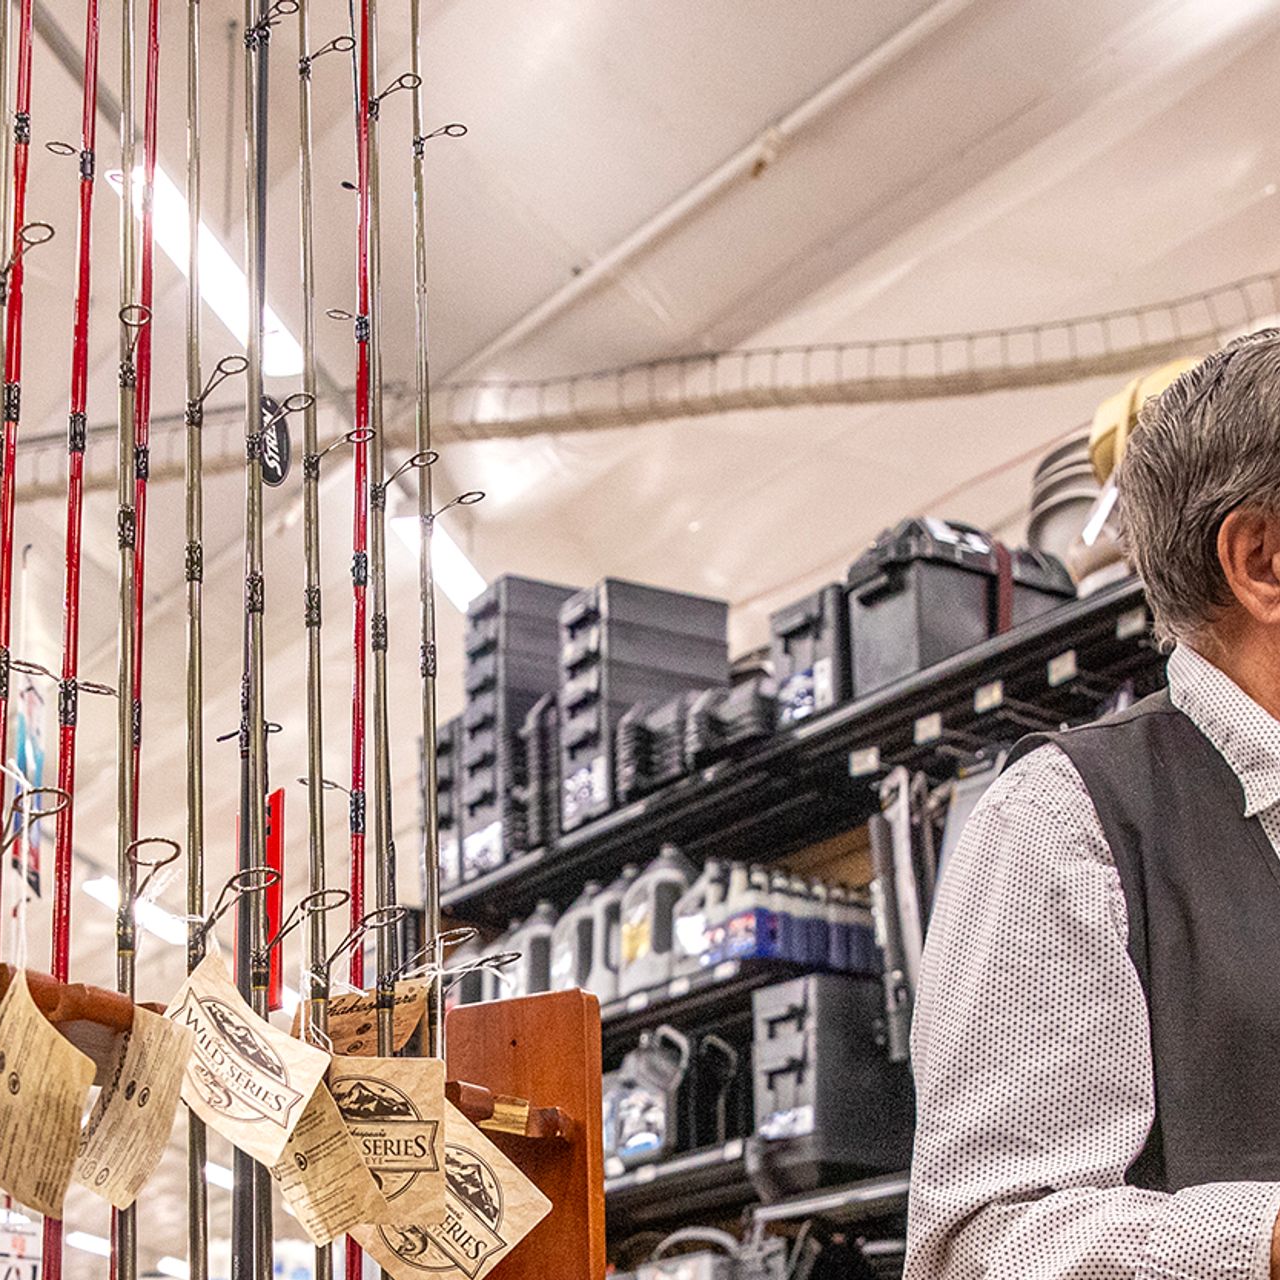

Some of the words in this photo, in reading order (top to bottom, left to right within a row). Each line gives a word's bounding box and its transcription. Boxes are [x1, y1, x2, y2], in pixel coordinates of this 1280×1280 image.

[184, 1007, 226, 1066] WILD
[228, 1065, 287, 1112] SERIES
[362, 1135, 430, 1159] SERIES
[440, 1213, 489, 1263] ERIES
